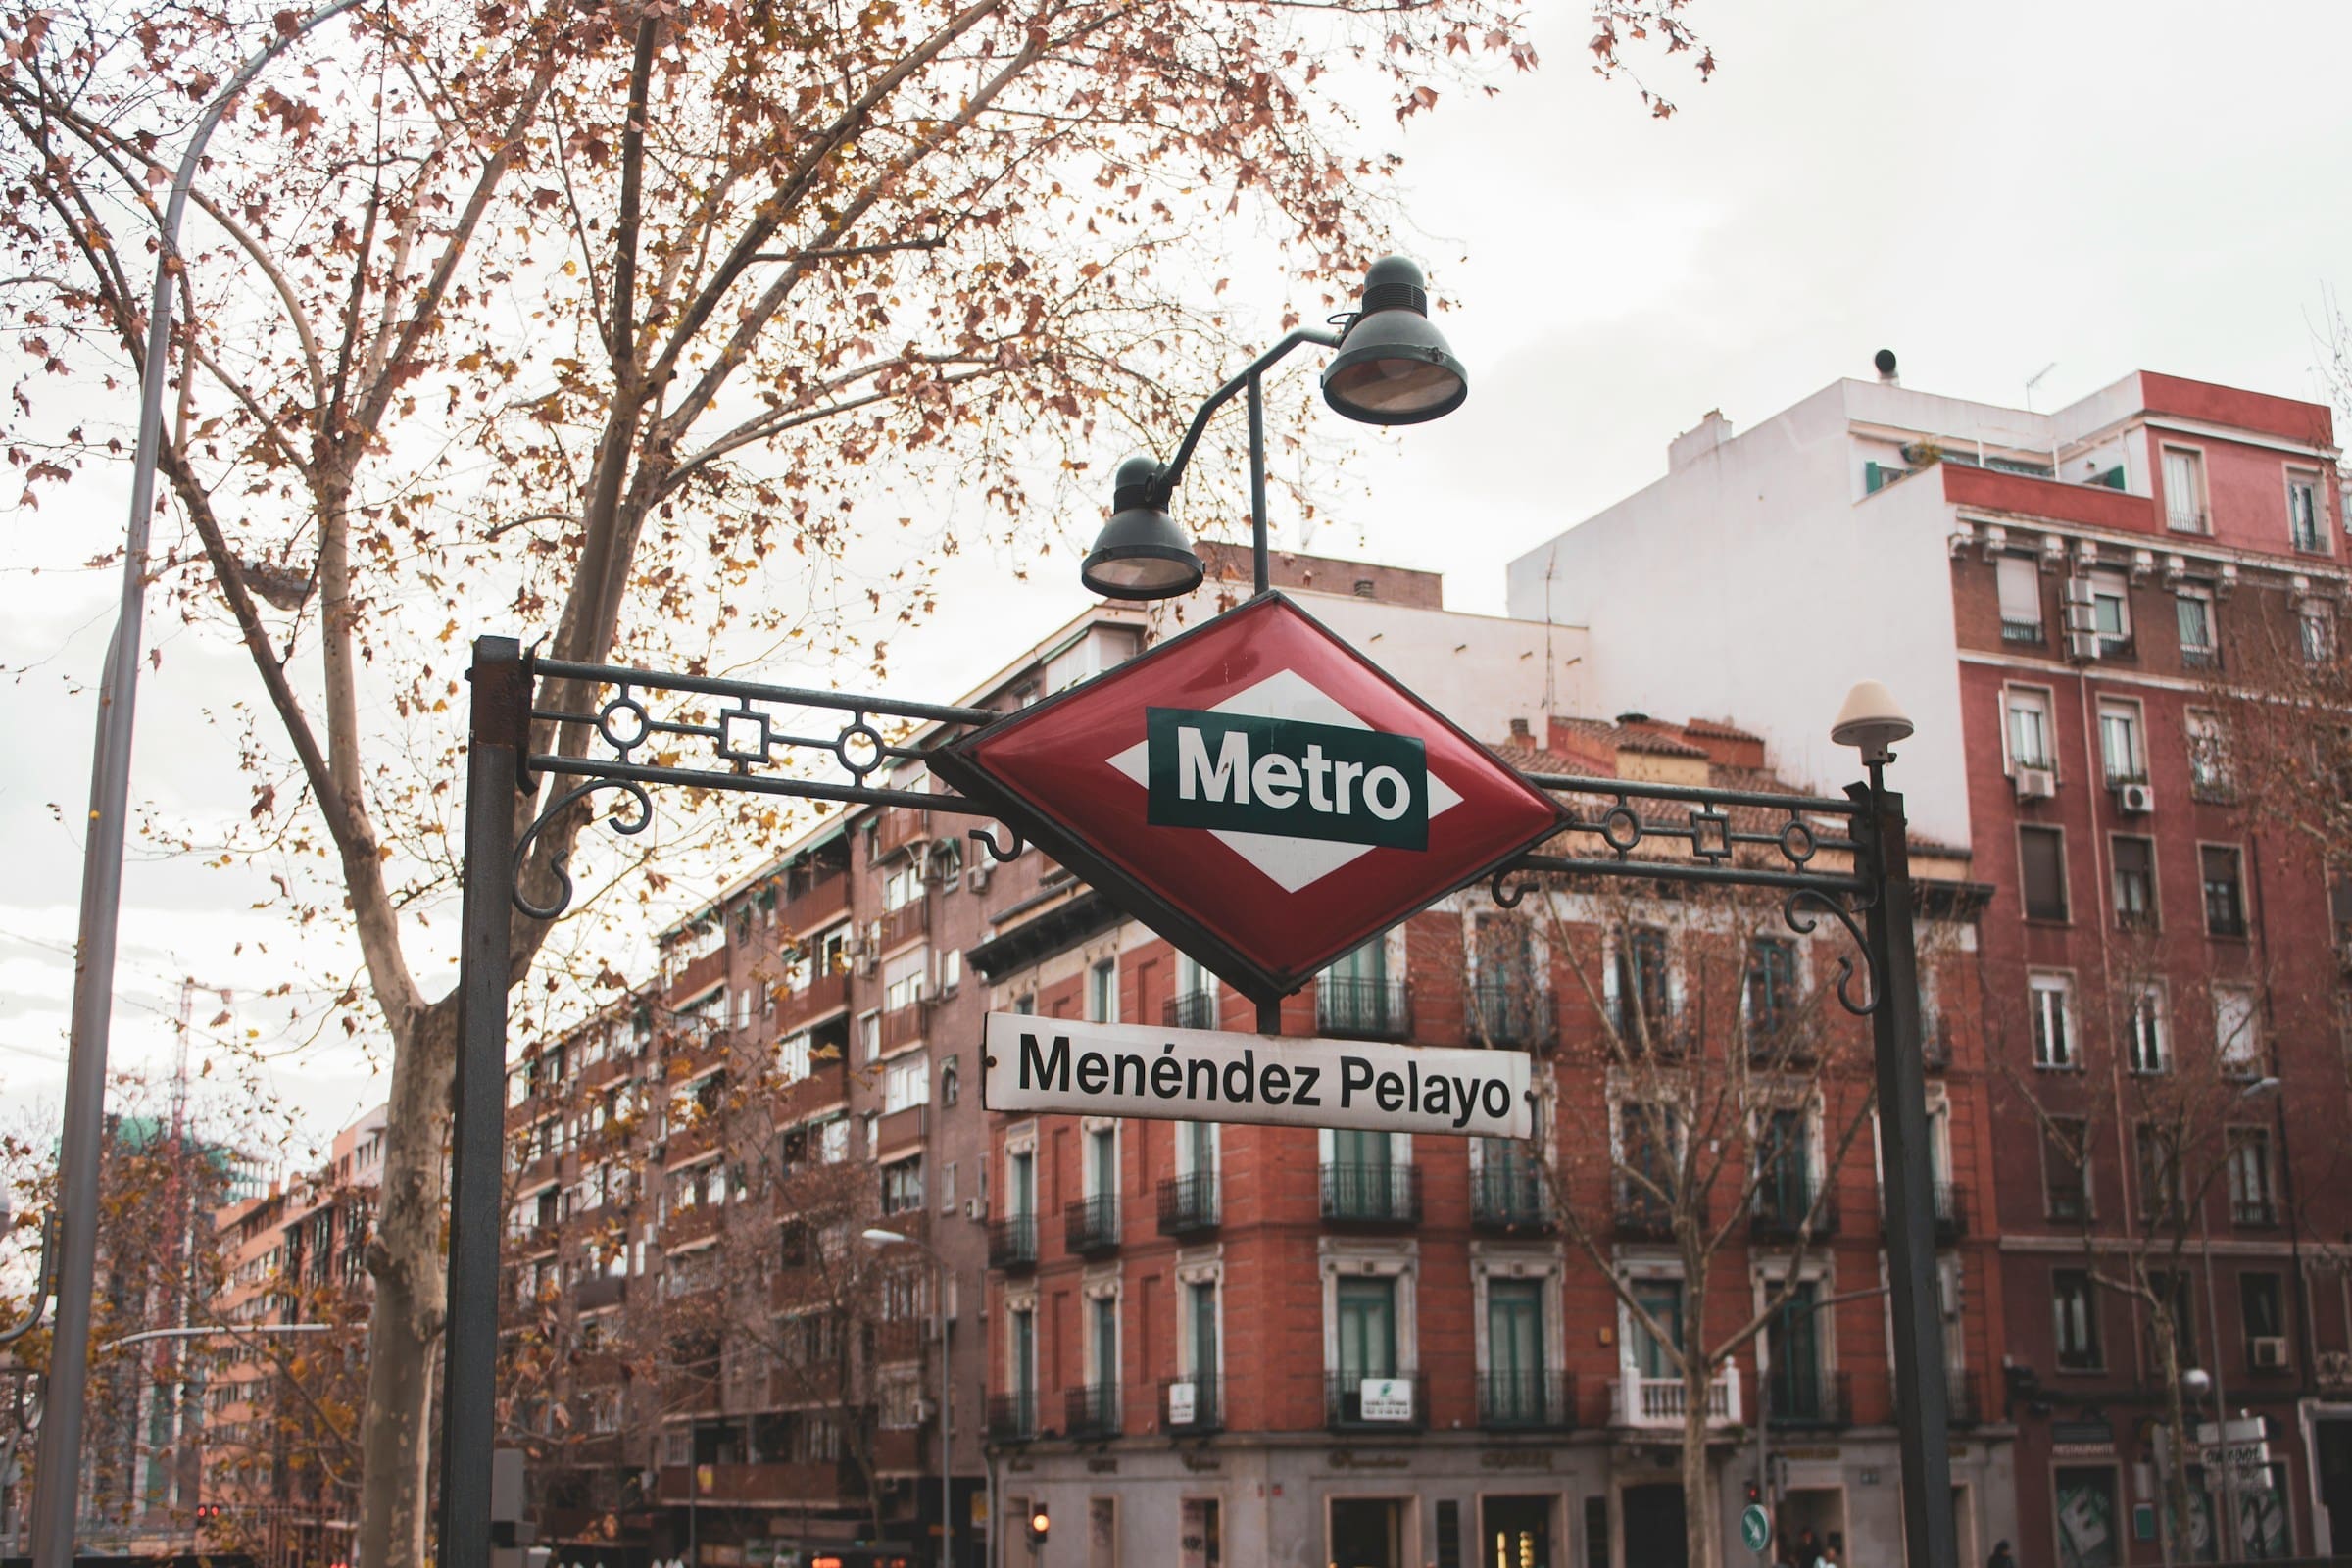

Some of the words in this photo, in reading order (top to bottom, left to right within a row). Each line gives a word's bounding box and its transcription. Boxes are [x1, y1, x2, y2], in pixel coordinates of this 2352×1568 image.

[1176, 725, 1411, 822] Metro
[1017, 1033, 1321, 1108] Menéndez
[1340, 1054, 1512, 1129] Pelayo
